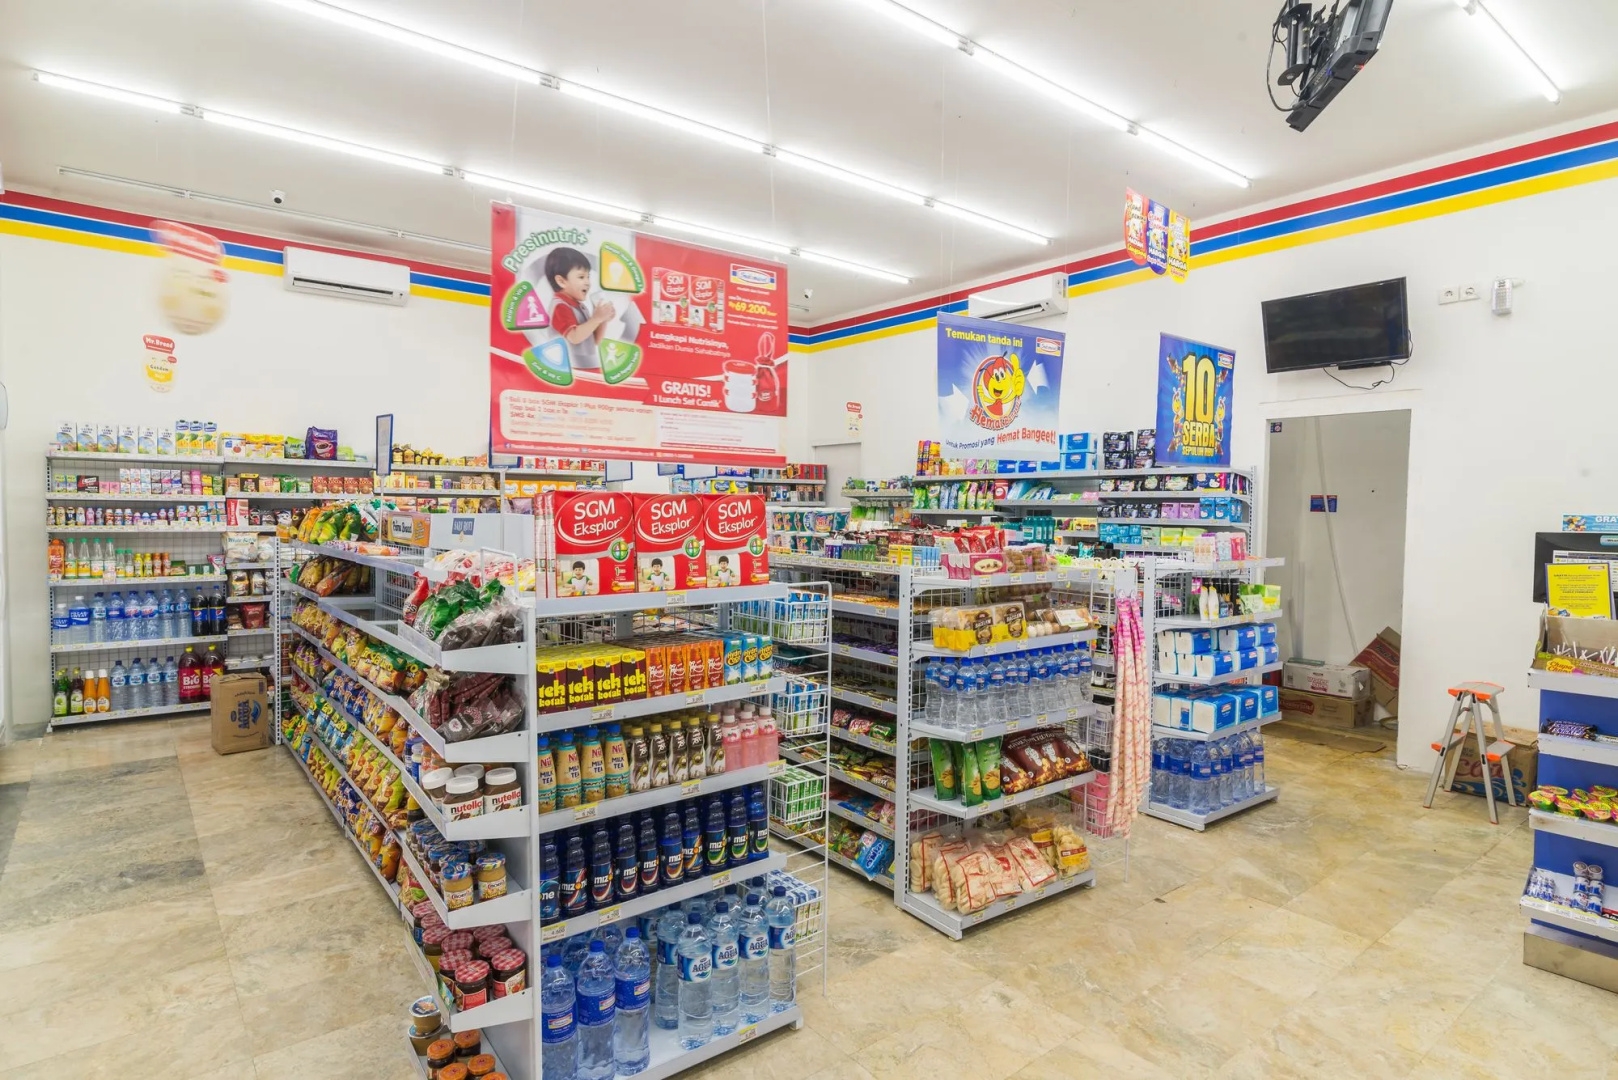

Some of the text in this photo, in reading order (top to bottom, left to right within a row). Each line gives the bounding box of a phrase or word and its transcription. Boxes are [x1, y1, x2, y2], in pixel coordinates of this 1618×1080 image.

[650, 331, 687, 343] Lengkapi
[945, 328, 1023, 347] Temukan tanda ini
[661, 380, 712, 398] GRATIS!
[1182, 353, 1216, 423] 10
[658, 395, 682, 405] Lunch
[682, 397, 695, 407] Set
[959, 441, 980, 450] Promosi
[980, 437, 995, 449] yang
[996, 428, 1020, 444] Hemat
[1021, 427, 1056, 444] Bangeet!
[1182, 420, 1215, 448] SERBA
[573, 497, 616, 520] SGM
[651, 498, 688, 521] SGM
[718, 498, 752, 521] SGM
[573, 517, 620, 537] Eksplor
[651, 517, 692, 536] Eksplor
[718, 517, 756, 534] Eksplor
[568, 676, 595, 694] teh
[597, 672, 621, 691] teh
[624, 668, 646, 686] teh
[539, 679, 566, 698] teh
[569, 692, 594, 703] kotak
[597, 689, 622, 700] kotak
[624, 684, 646, 695] kotak
[539, 697, 566, 708] kotak
[540, 770, 553, 778] MILK
[492, 790, 522, 805] nutella
[451, 800, 483, 814] nutella
[718, 947, 738, 960] AQUA
[749, 938, 768, 951] AQUA
[692, 959, 712, 973] AQUA
